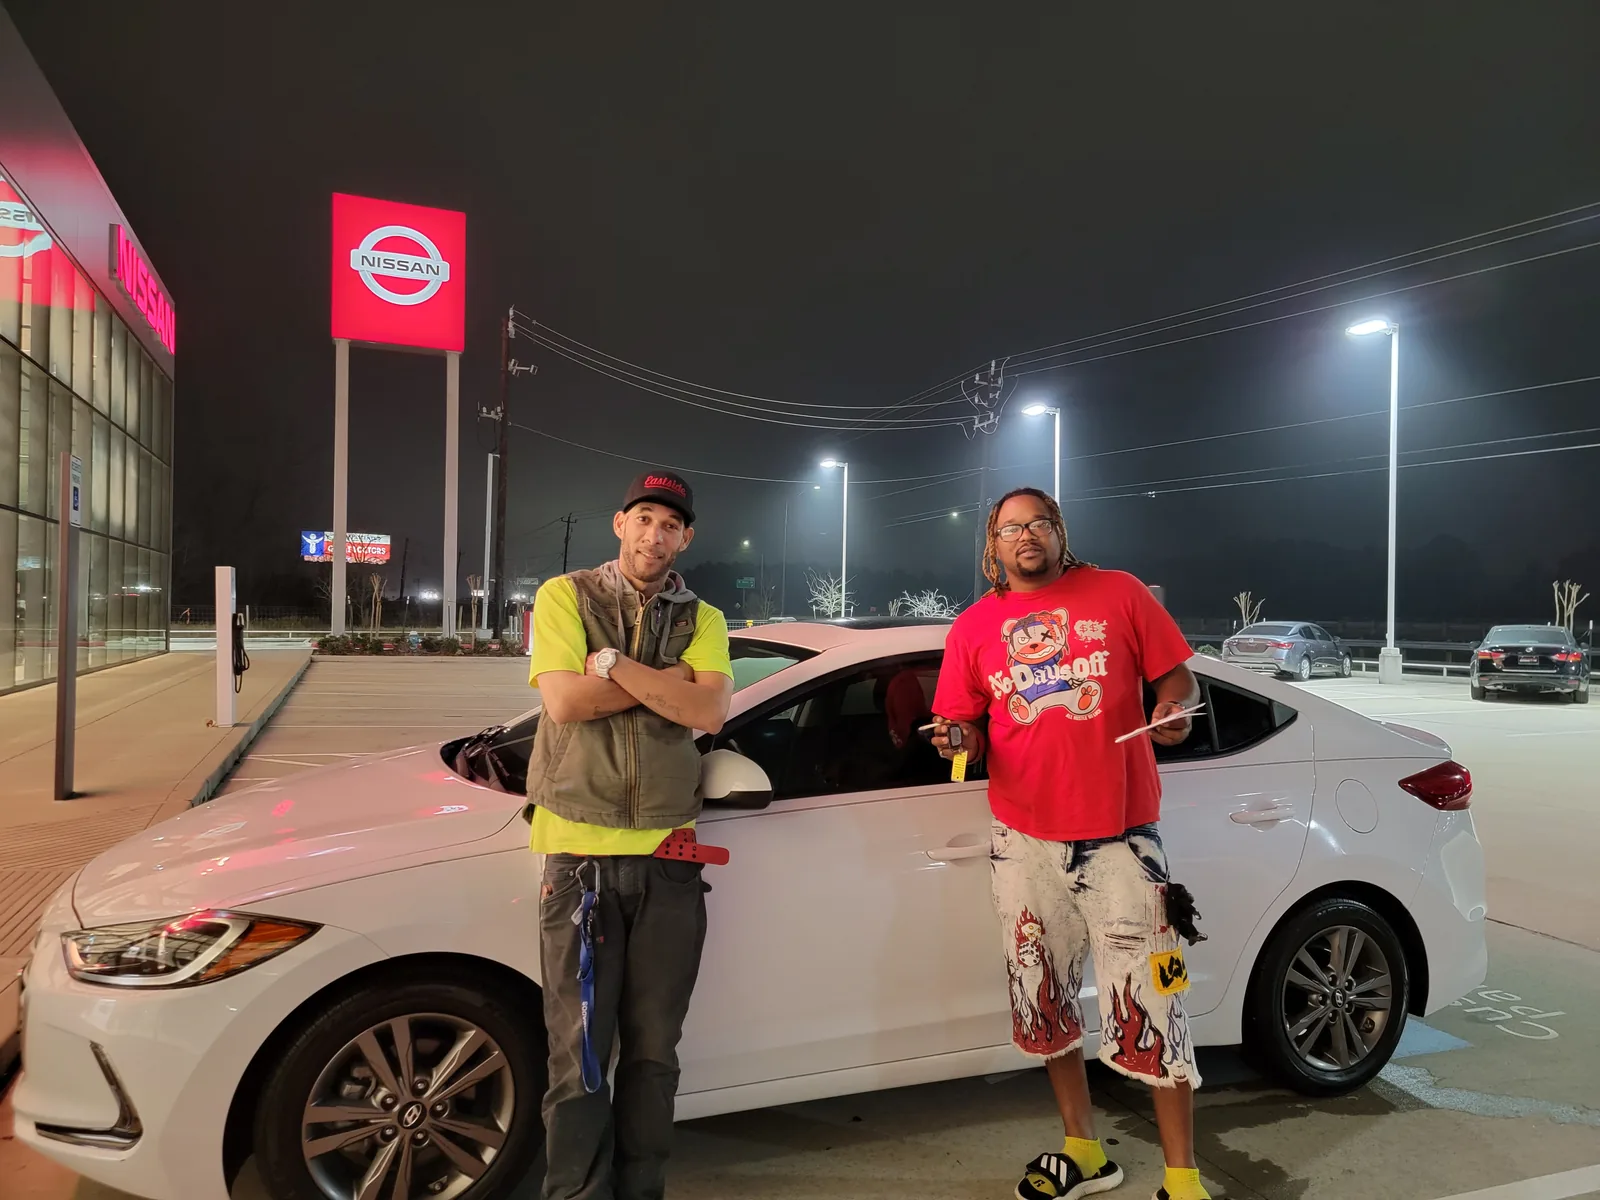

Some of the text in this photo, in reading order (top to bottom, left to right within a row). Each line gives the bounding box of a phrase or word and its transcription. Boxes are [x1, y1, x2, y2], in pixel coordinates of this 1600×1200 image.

[361, 255, 440, 275] NISSAN
[117, 223, 175, 355] NISSAN
[644, 475, 686, 496] Eastside
[988, 650, 1110, 700] No Days Off
